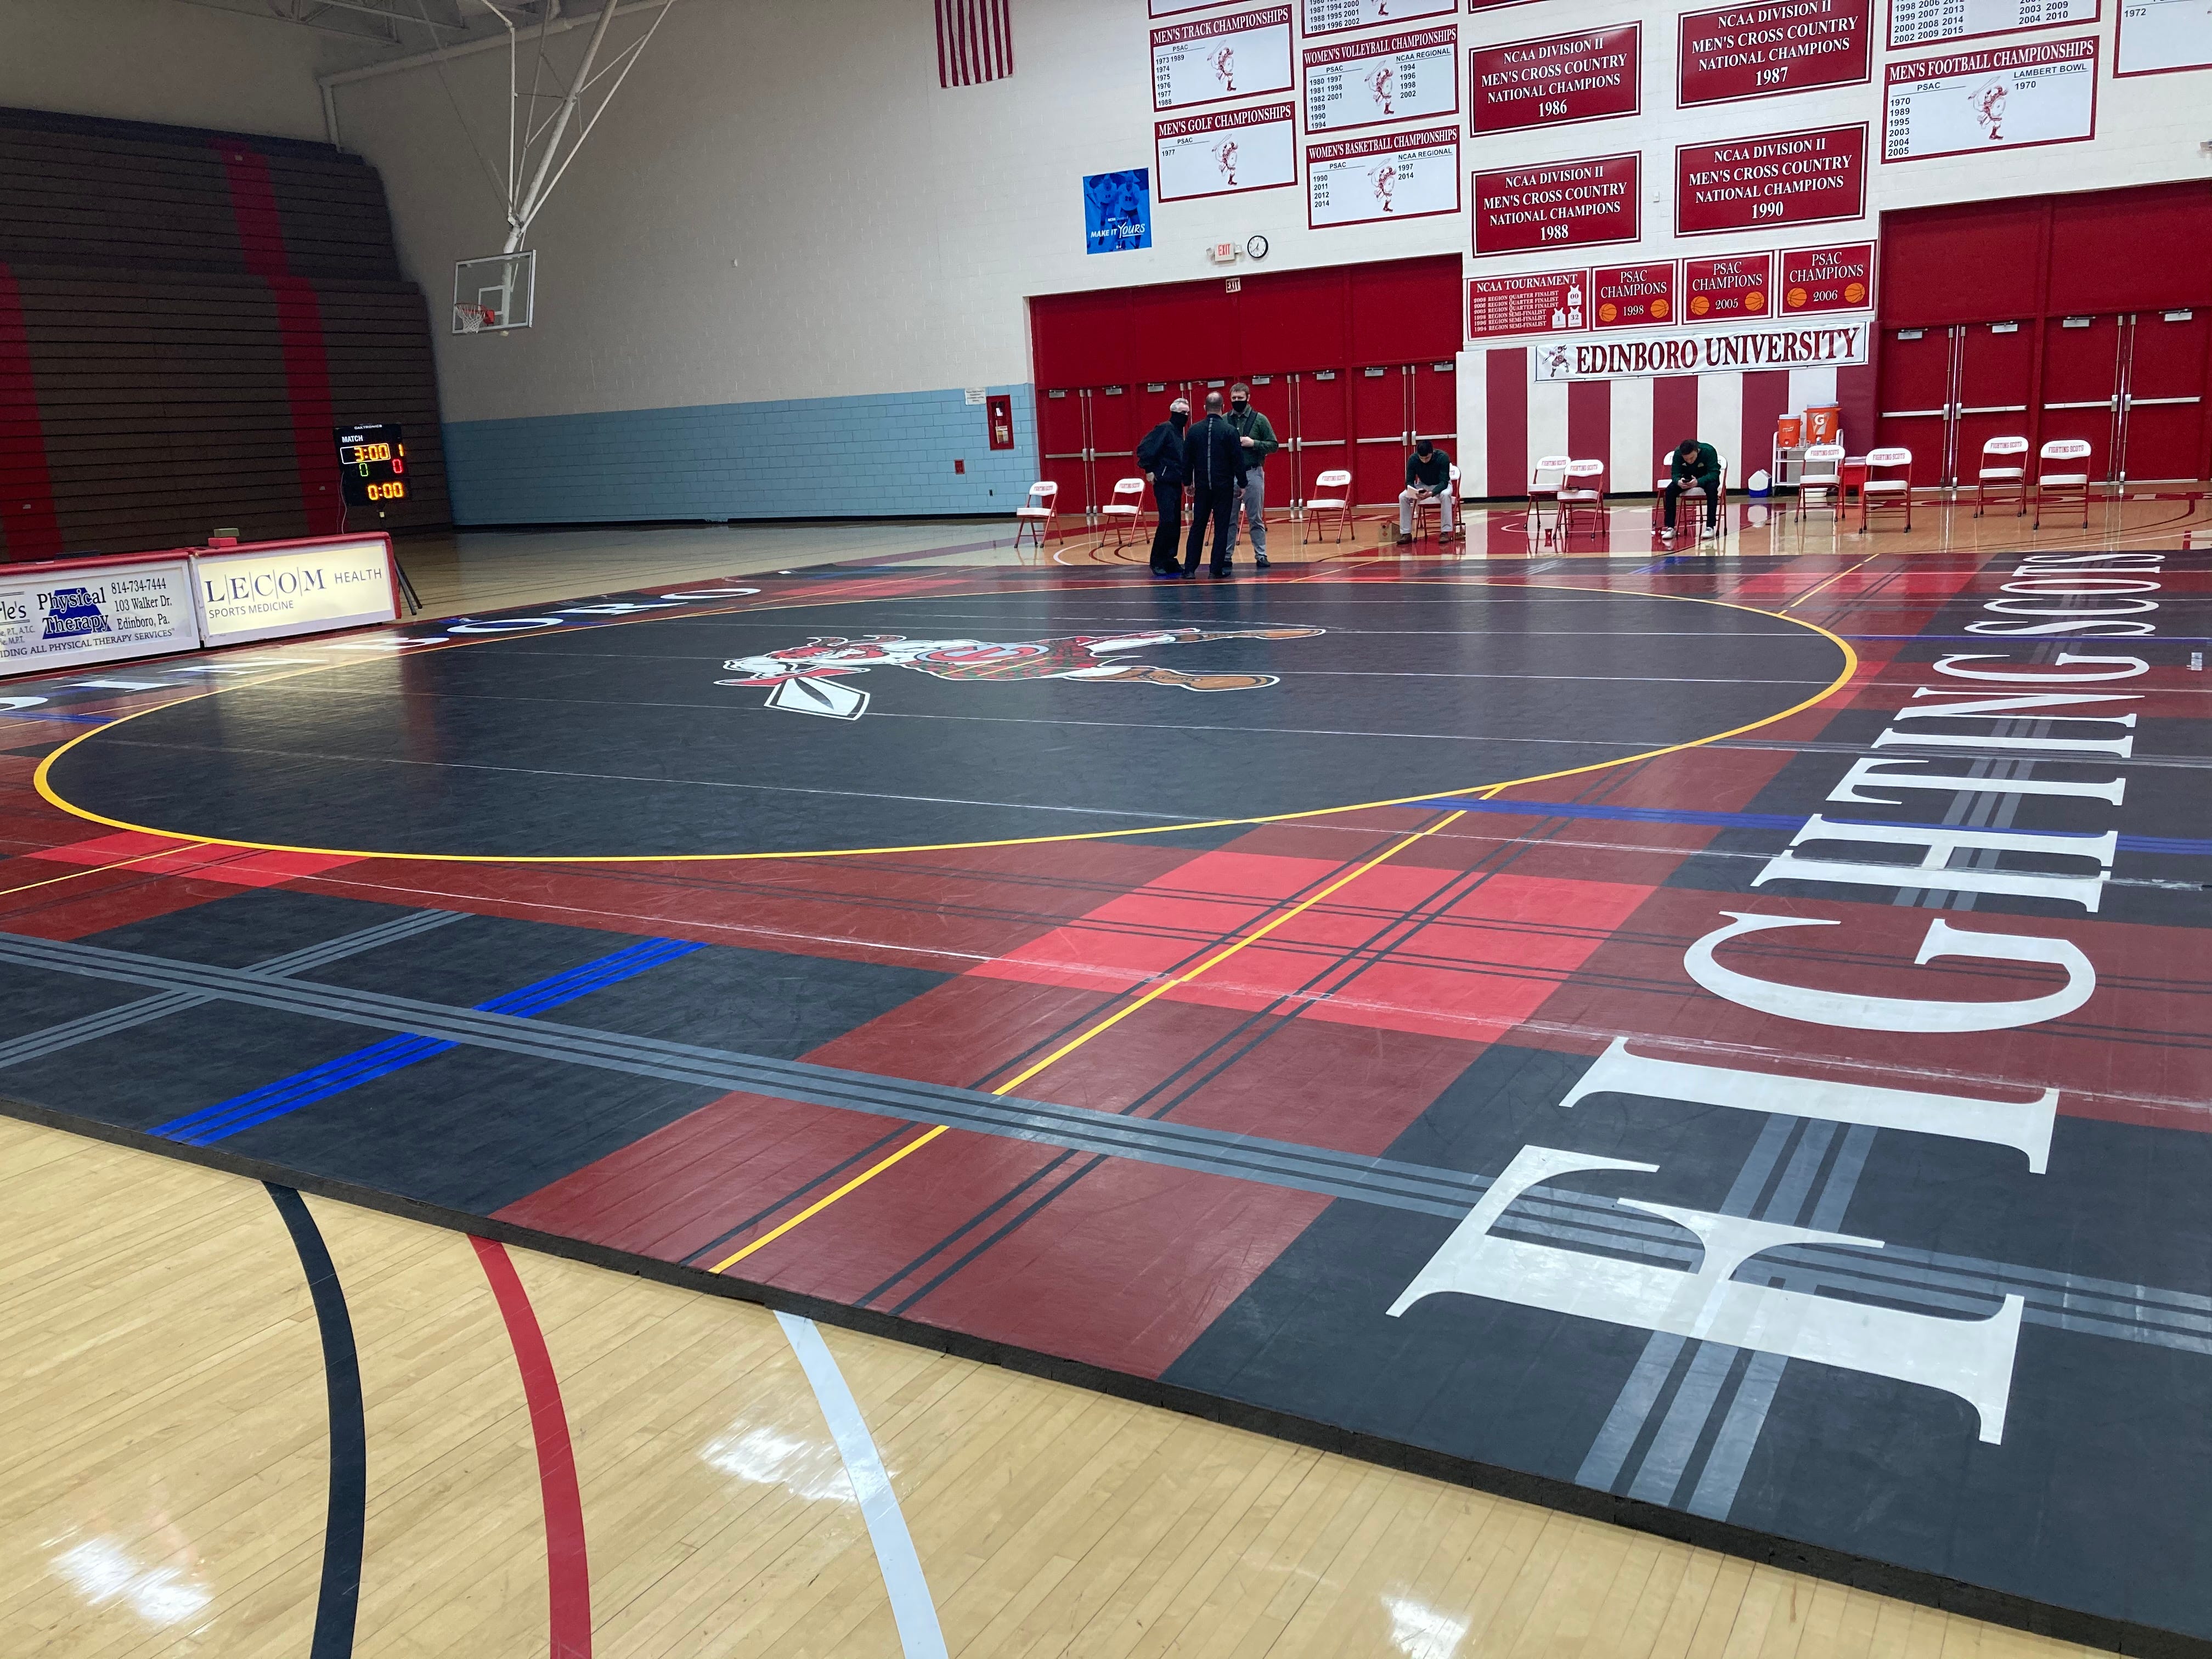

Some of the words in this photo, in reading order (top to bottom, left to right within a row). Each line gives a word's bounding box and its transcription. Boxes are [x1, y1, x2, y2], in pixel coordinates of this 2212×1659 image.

[1718, 13, 1754, 29] NCAA
[1758, 1, 1818, 22] DIVISION
[1821, 0, 1831, 12] II
[2019, 14, 2040, 25] 2004
[2046, 10, 2068, 21] 2010
[2124, 8, 2146, 18] 1972
[1153, 28, 1180, 44] MEN'S
[1182, 22, 1212, 38] TRACK
[1214, 8, 1288, 33] CHAMPIONSHIPS
[1894, 23, 1915, 33] 2000
[1918, 20, 1938, 30] 2008
[1942, 15, 1963, 26] 2014
[1692, 35, 1734, 54] MEN'S
[1738, 28, 1783, 46] CROSS
[1787, 16, 1858, 39] COUNTRY
[1894, 33, 1915, 43] 2002
[1918, 30, 1938, 40] 2009
[1942, 26, 1963, 36] 2015
[1304, 48, 1340, 64] WOMEN'S
[1341, 40, 1390, 58] VOLLEYBALL
[1392, 28, 1456, 50] CHAMPIONSHIPS
[1396, 53, 1414, 61] NCAA
[1417, 48, 1451, 58] REGIONAL
[1504, 49, 1536, 64] NCAA
[1539, 40, 1592, 59] DIVISION
[1595, 37, 1604, 50] II
[1699, 50, 1765, 71] NATIONAL
[1769, 37, 1849, 60] CHAMPIONS
[1400, 63, 1415, 71] 1994
[1889, 63, 1925, 81] MEN'S
[1928, 54, 1991, 76] FOOTBALL
[1994, 40, 2094, 67] CHAMPIONSHIPS
[1482, 70, 1518, 87] MEN'S
[1521, 64, 1561, 81] CROSS
[1568, 54, 1627, 76] COUNTRY
[1756, 66, 1788, 86] 1987
[2014, 66, 2057, 78] LAMBERT
[2060, 63, 2087, 72] BOWL
[1488, 85, 1546, 103] NATIONAL
[1549, 74, 1620, 94] CHAMPIONS
[1917, 82, 1940, 91] PSAC
[2015, 81, 2036, 90] 1970
[1401, 90, 1416, 99] 2002
[1891, 98, 1910, 106] 1970
[1539, 99, 1567, 117] 1986
[1890, 108, 1910, 116] 1989
[1159, 121, 1186, 136] MEN'S
[1188, 117, 1212, 132] GOLF
[1215, 105, 1291, 128] CHAMPIONSHIPS
[1889, 128, 1909, 137] 2003
[1309, 144, 1344, 159] WOMEN'S
[1345, 138, 1392, 155] BASKETBALL
[1394, 128, 1457, 148] CHAMPIONSHIPS
[1714, 148, 1750, 162] NCAA
[1753, 139, 1813, 158] DIVISION
[1816, 138, 1826, 150] II
[1889, 138, 1909, 147] 2004
[1419, 148, 1452, 157] REGIONAL
[1888, 147, 1909, 156] 2005
[1505, 174, 1537, 188] NCAA
[1540, 167, 1592, 184] DIVISION
[1595, 166, 1603, 177] II
[1689, 170, 1730, 186] MEN'S
[1734, 164, 1778, 180] CROSS
[1782, 155, 1852, 175] COUNTRY
[1484, 194, 1520, 210] MEN'S
[1523, 190, 1562, 205] CROSS
[1568, 182, 1627, 202] COUNTRY
[1696, 185, 1761, 203] NATIONAL
[1764, 176, 1843, 195] CHAMPIONS
[1490, 210, 1547, 226] NATIONAL
[1550, 201, 1620, 219] CHAMPIONS
[1752, 201, 1783, 218] 1990
[1091, 229, 1109, 238] MAKE
[1118, 222, 1145, 238] YOURS
[1541, 224, 1568, 240] 1988
[1218, 244, 1231, 256] EXIT
[1812, 252, 1842, 266] PSAC
[1621, 269, 1647, 283] PSAC
[1713, 262, 1741, 275] PSAC
[1790, 264, 1863, 283] CHAMPIONS
[1477, 281, 1502, 292] NCAA
[1504, 274, 1578, 290] TOURNAMENT
[1601, 281, 1667, 298] CHAMPIONS
[1692, 274, 1762, 291] CHAMPIONS
[1716, 298, 1738, 309] 2005
[1813, 290, 1838, 302] 2006
[1624, 305, 1644, 316] 1998
[1575, 340, 1698, 374] EDINBORO
[1704, 327, 1860, 366] UNIVERSITY
[354, 444, 389, 461] 3:00
[398, 444, 404, 456] 1
[359, 463, 369, 477] 0
[392, 459, 403, 473] 0
[368, 482, 404, 500] 0:00
[335, 568, 382, 584] HEALTH
[111, 578, 166, 594] 814-734-7444
[37, 587, 106, 613] Physical
[114, 599, 129, 612] 103
[131, 597, 158, 610] Walker
[160, 595, 172, 606] Dr.
[209, 606, 246, 618] SPORTS
[249, 600, 294, 613] MEDICINE
[42, 614, 109, 634] Therapy
[116, 616, 156, 630] Edinboro,
[157, 613, 170, 625] Pa.
[30, 645, 47, 654] ALL
[48, 640, 92, 652] PHYSICAL
[93, 634, 132, 645] THERAPY
[1385, 653, 2151, 1444] FIGHTING
[1964, 554, 2165, 636] SCOTS
